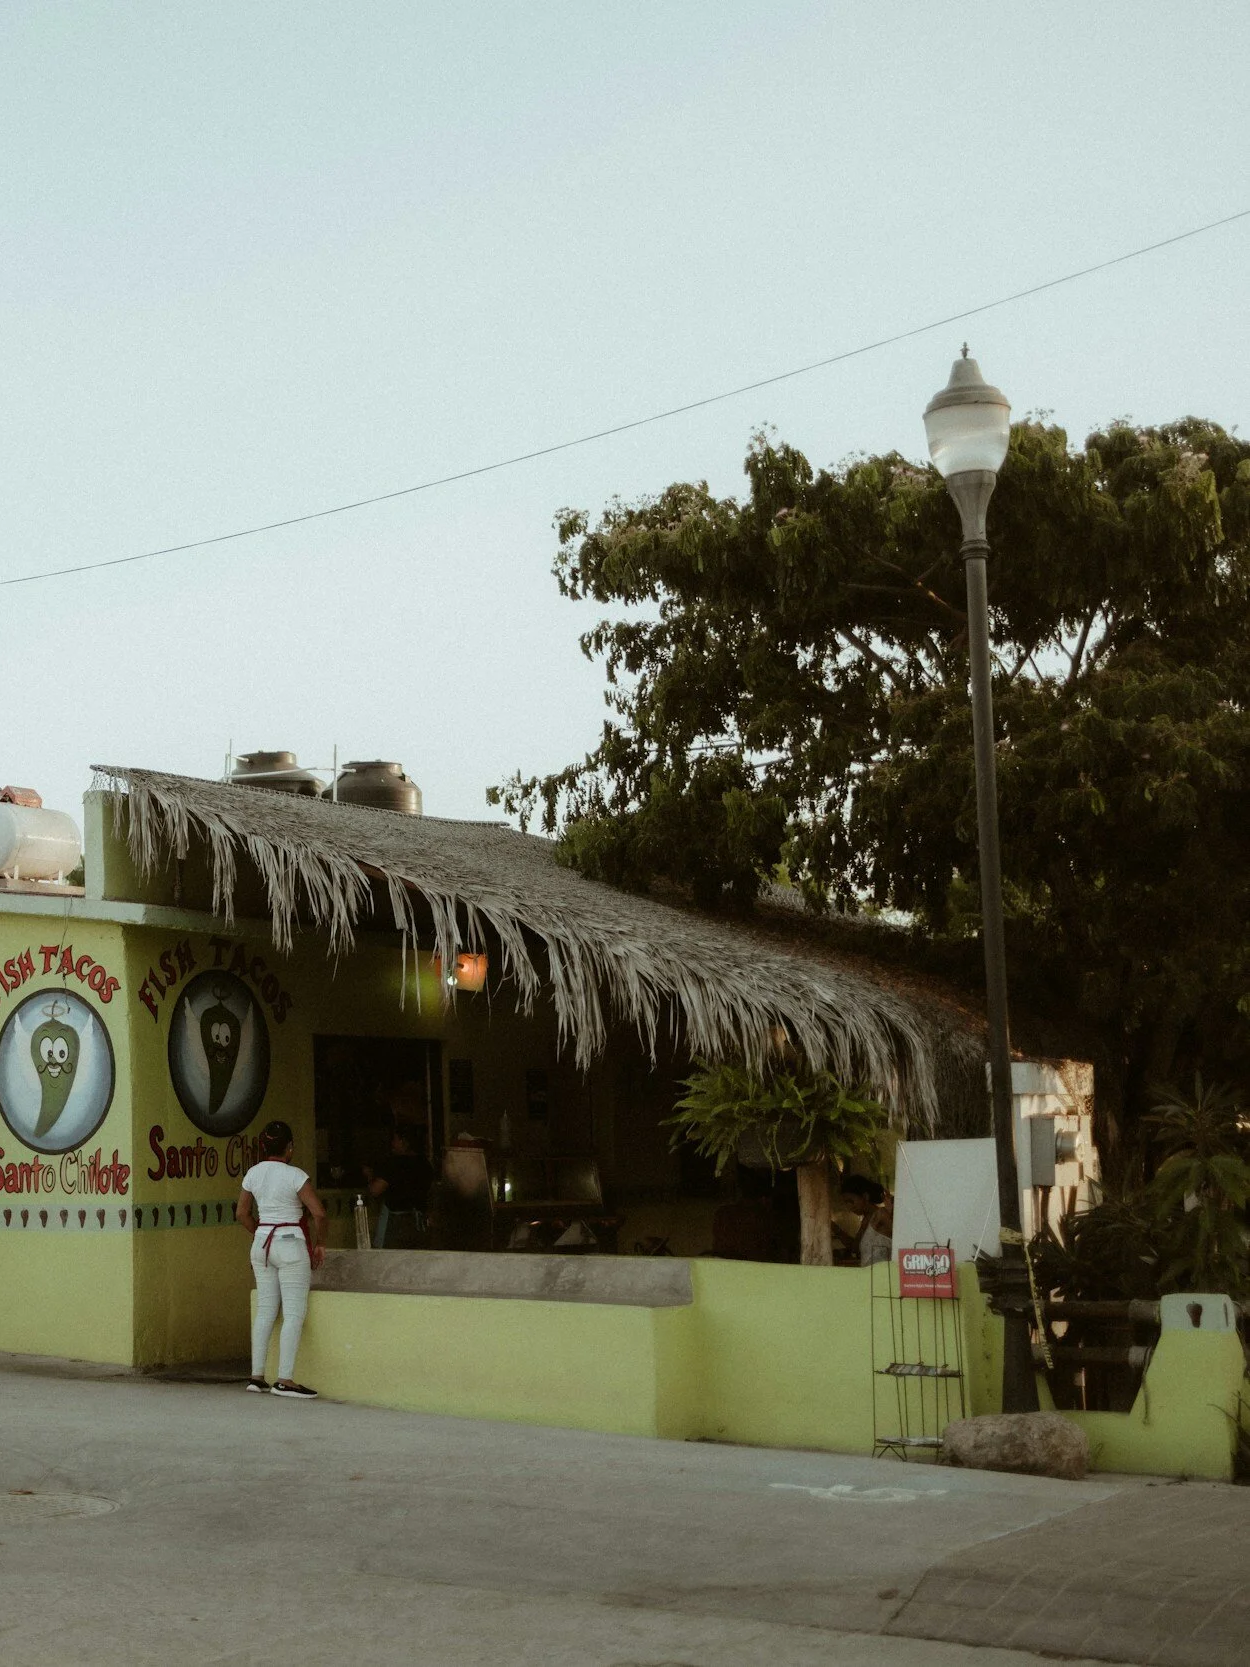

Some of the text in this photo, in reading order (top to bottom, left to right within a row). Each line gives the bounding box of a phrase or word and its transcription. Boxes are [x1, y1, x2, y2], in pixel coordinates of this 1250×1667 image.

[38, 944, 122, 1004] TACOS
[138, 933, 294, 1025] FISH TACOS
[59, 1147, 131, 1196] Chilote
[147, 1125, 219, 1181] Santo
[902, 1254, 950, 1270] GRINGO
